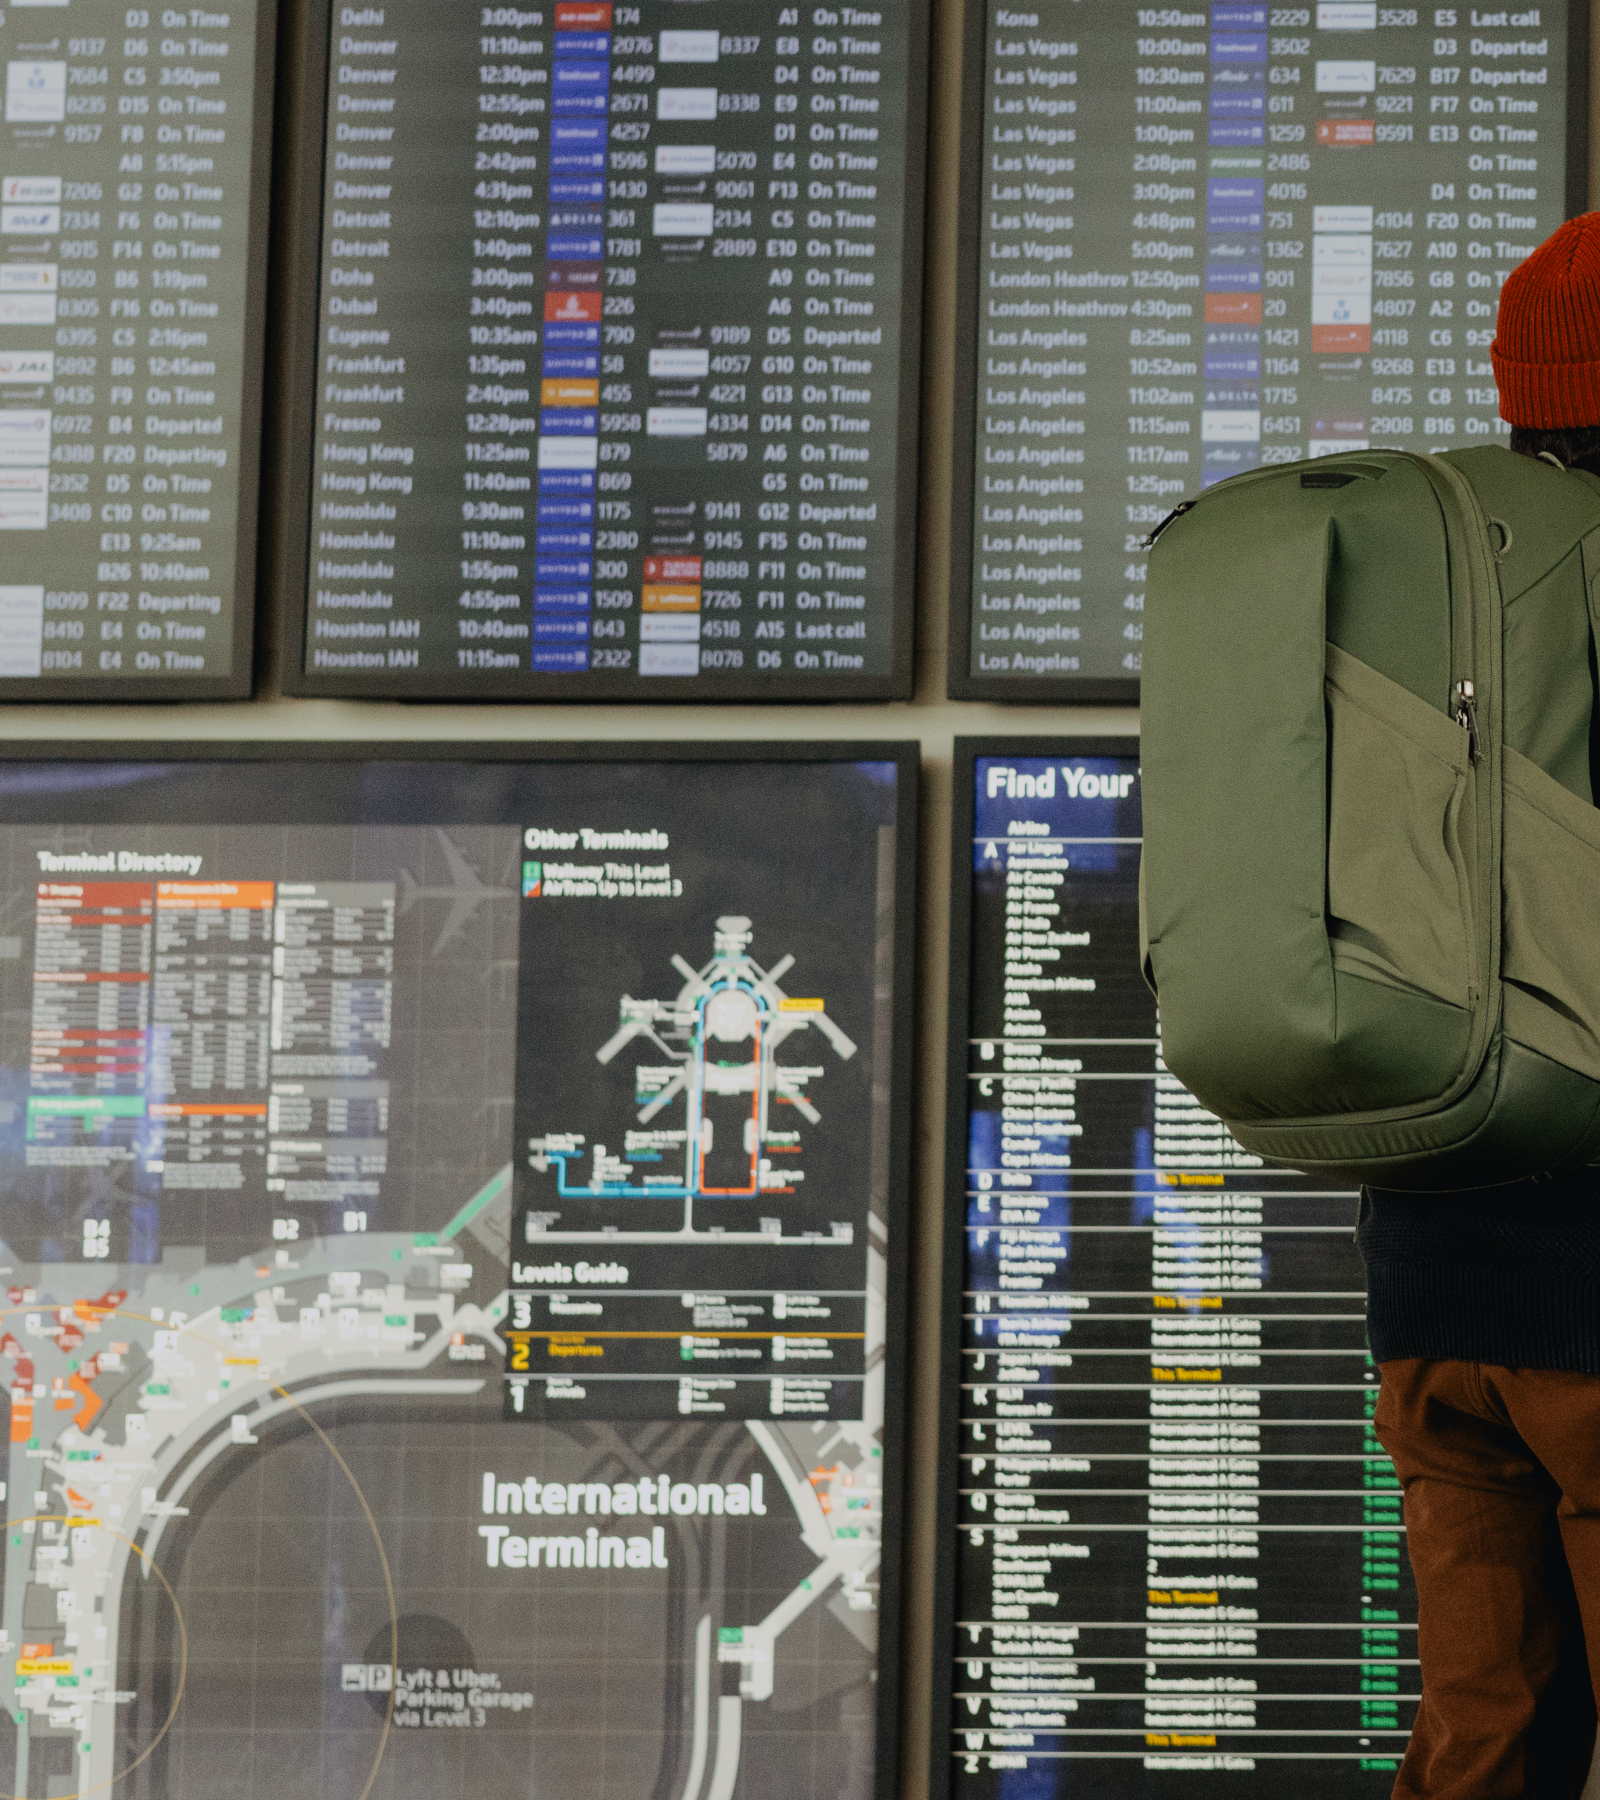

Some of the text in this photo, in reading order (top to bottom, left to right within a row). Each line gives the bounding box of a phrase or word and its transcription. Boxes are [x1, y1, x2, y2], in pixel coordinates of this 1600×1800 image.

[162, 10, 186, 27] On
[194, 10, 229, 27] Time
[993, 154, 1537, 174] Las Vegas 2:08pm 2486 On Time
[333, 210, 390, 227] Detroit
[771, 211, 793, 227] C5
[808, 211, 832, 227] On
[838, 211, 875, 227] Time
[988, 329, 1191, 349] Los Angeles 8:25am
[323, 444, 367, 464] Hong
[370, 444, 413, 464] Kong
[988, 766, 1133, 799] Find Your
[525, 828, 669, 850] Other Terminals
[37, 850, 203, 876] Terminal Directory
[542, 880, 597, 896] AirTrain
[636, 881, 671, 897] Level
[672, 879, 682, 898] 3
[83, 1218, 110, 1238] B4
[272, 1218, 299, 1240] B2
[343, 1210, 367, 1231] B1
[82, 1238, 109, 1258] B5
[512, 1261, 629, 1283] Levels Guide
[512, 1301, 531, 1329] 3
[511, 1343, 530, 1370] 2
[510, 1385, 525, 1412] 1
[482, 1472, 766, 1515] International
[478, 1526, 667, 1568] Terminal
[395, 1668, 433, 1691] Lyft
[436, 1669, 450, 1688] &
[395, 1688, 533, 1711] Parking Garage
[393, 1707, 486, 1727] via Level 3
